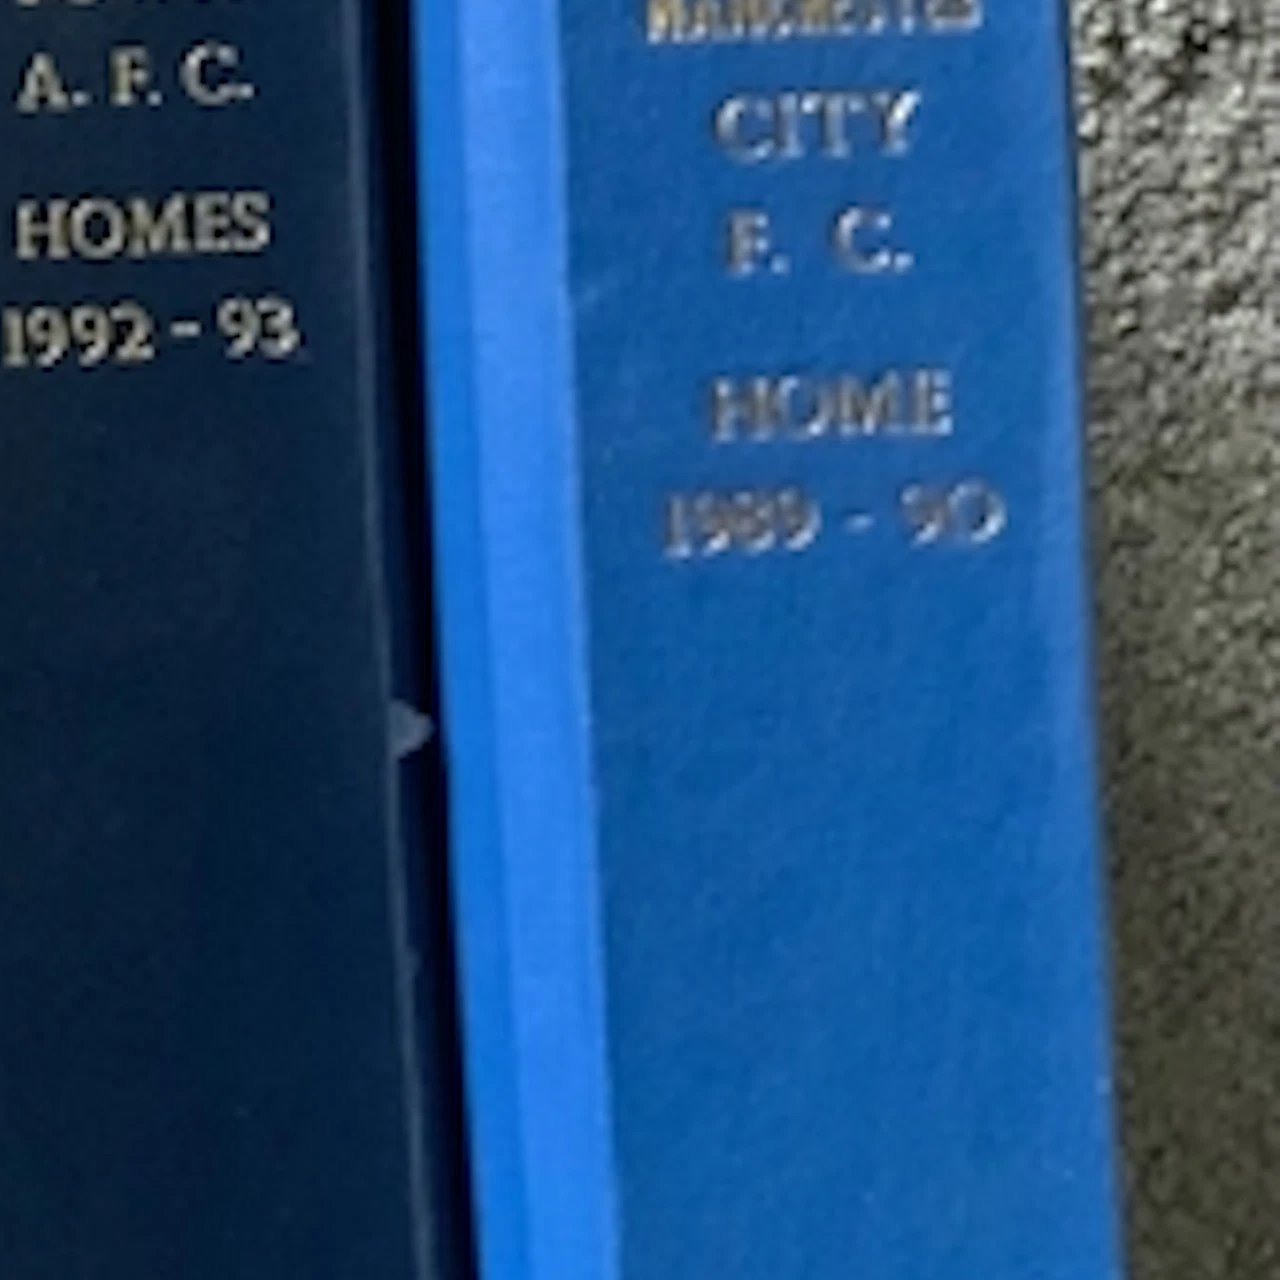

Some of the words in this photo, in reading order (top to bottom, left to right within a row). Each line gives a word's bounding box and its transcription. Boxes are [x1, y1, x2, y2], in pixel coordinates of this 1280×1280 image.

[713, 90, 922, 163] CITY
[15, 189, 274, 262] HOMES
[0, 298, 157, 369] 1992
[215, 294, 301, 359] 93
[710, 367, 954, 443] HOME
